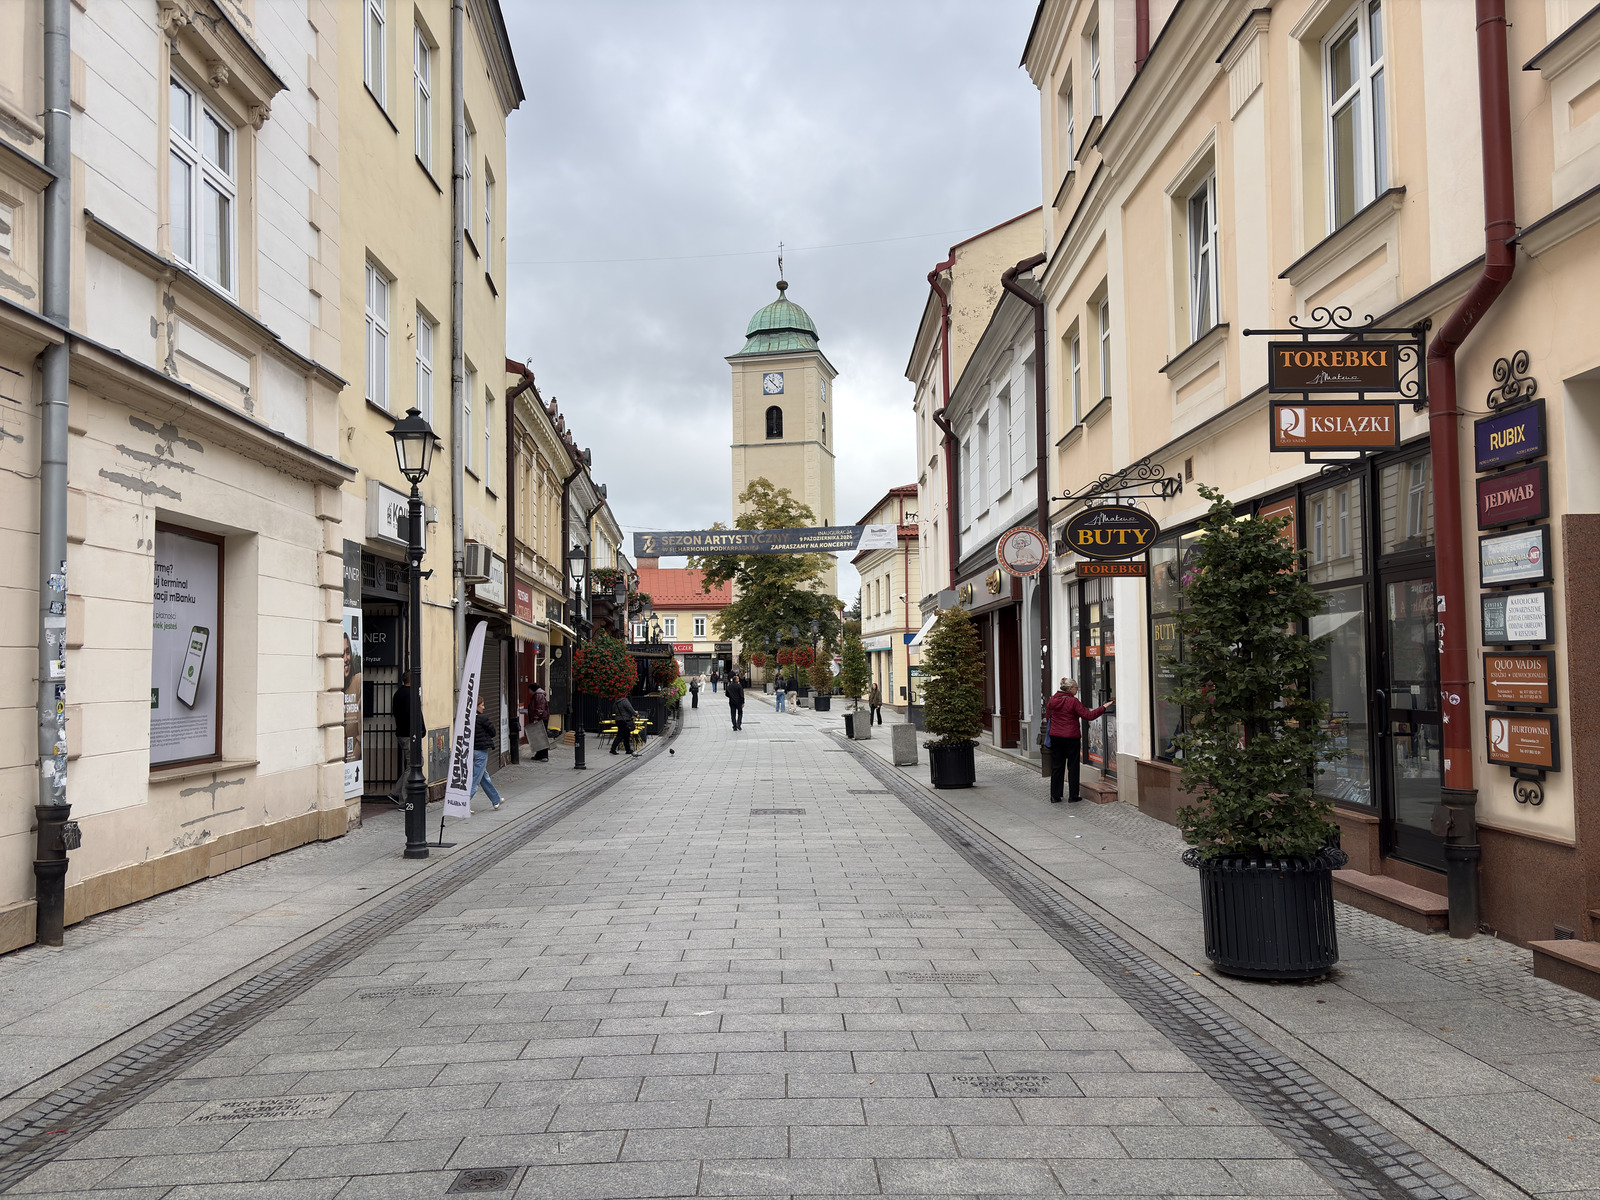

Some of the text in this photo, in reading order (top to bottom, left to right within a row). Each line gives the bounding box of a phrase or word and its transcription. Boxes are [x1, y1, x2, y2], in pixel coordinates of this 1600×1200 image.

[1280, 350, 1388, 368] TOREBKI
[1310, 416, 1391, 437] KSIĄŻKI
[1489, 423, 1526, 452] RUBIX
[1483, 483, 1535, 513] JEDWAB
[661, 535, 702, 546] SEZON
[704, 533, 789, 546] ARTYSTYCZNY
[1076, 528, 1151, 546] BUTY
[770, 543, 809, 551] ZAPRASZAMY
[820, 541, 853, 549] KONCERTY!
[154, 562, 174, 575] irmę?
[1081, 564, 1143, 574] TOREBKI
[161, 577, 188, 589] terminal
[169, 592, 196, 604] mBanku
[1510, 597, 1539, 606] KATOLICKIE
[1154, 623, 1176, 641] BUTY
[1494, 659, 1542, 672] QUO VADIS
[1511, 725, 1549, 736] HURTOWNIA
[450, 734, 464, 790] KAWA
[405, 803, 414, 811] 29
